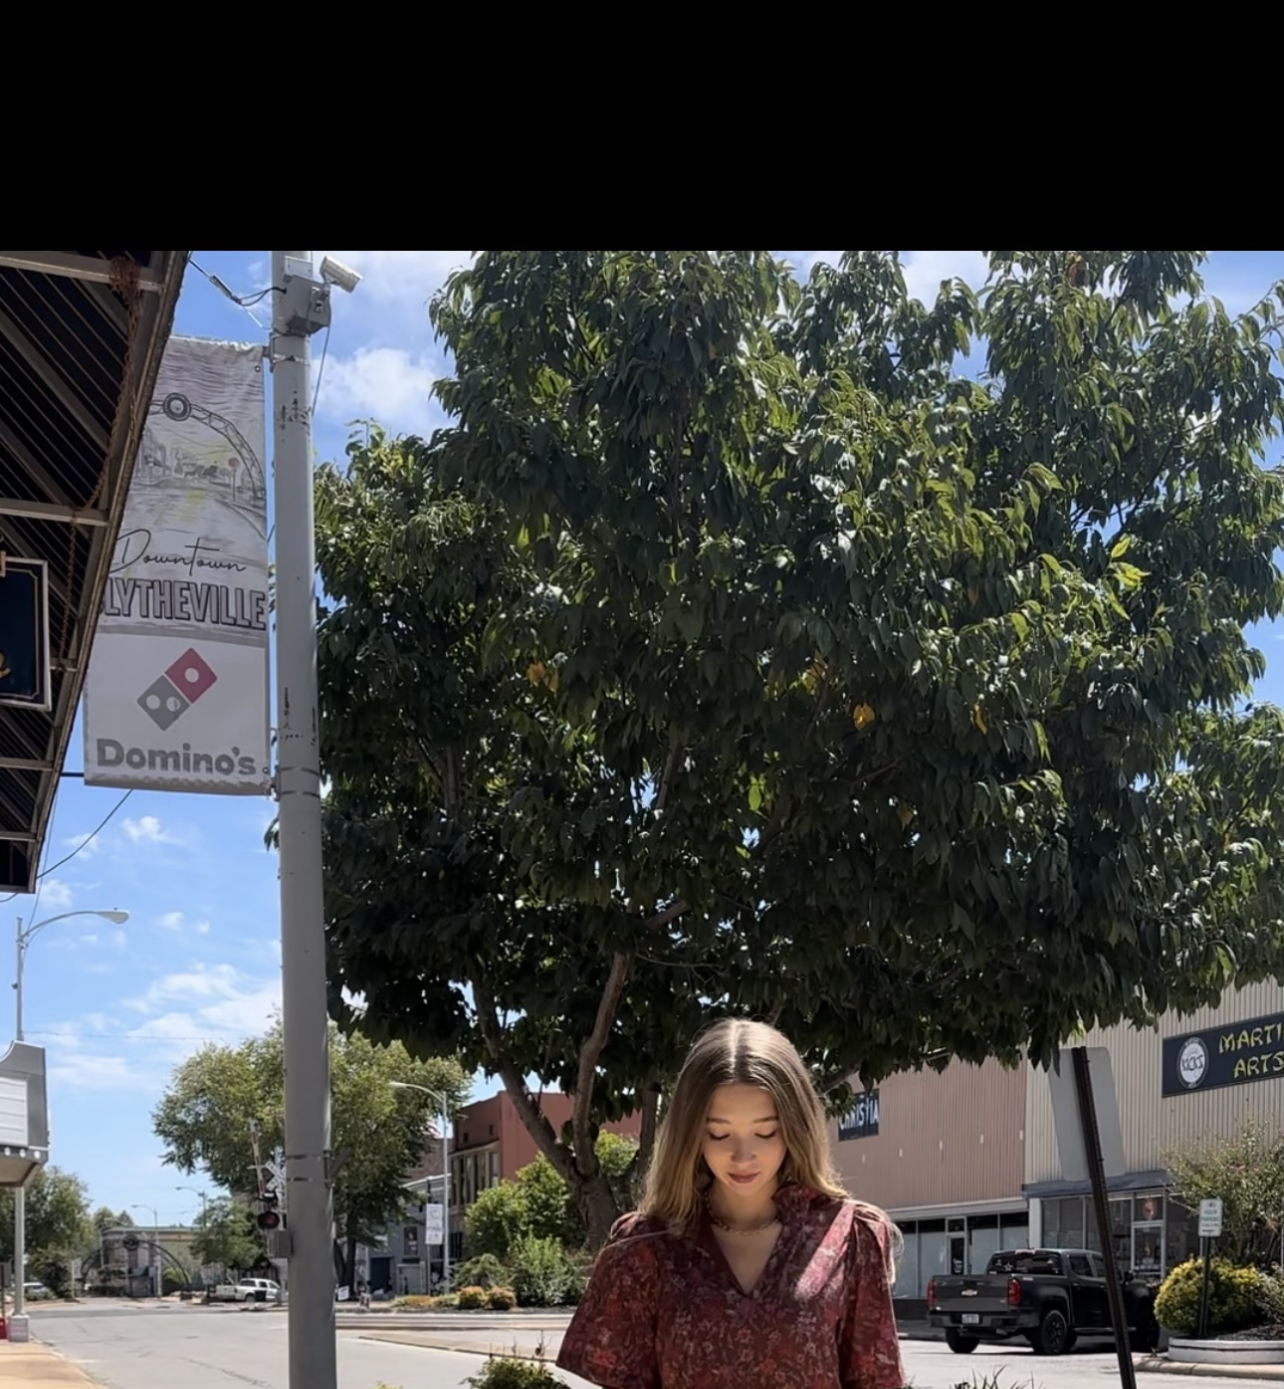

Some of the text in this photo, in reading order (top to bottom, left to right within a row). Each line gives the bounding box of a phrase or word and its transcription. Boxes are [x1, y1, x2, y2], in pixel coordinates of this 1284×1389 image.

[110, 528, 247, 577] Downtown
[101, 577, 267, 631] LYTHEVILLE
[96, 738, 256, 775] Domino's
[1219, 1022, 1284, 1054] MARTI
[1233, 1051, 1284, 1079] ARTS
